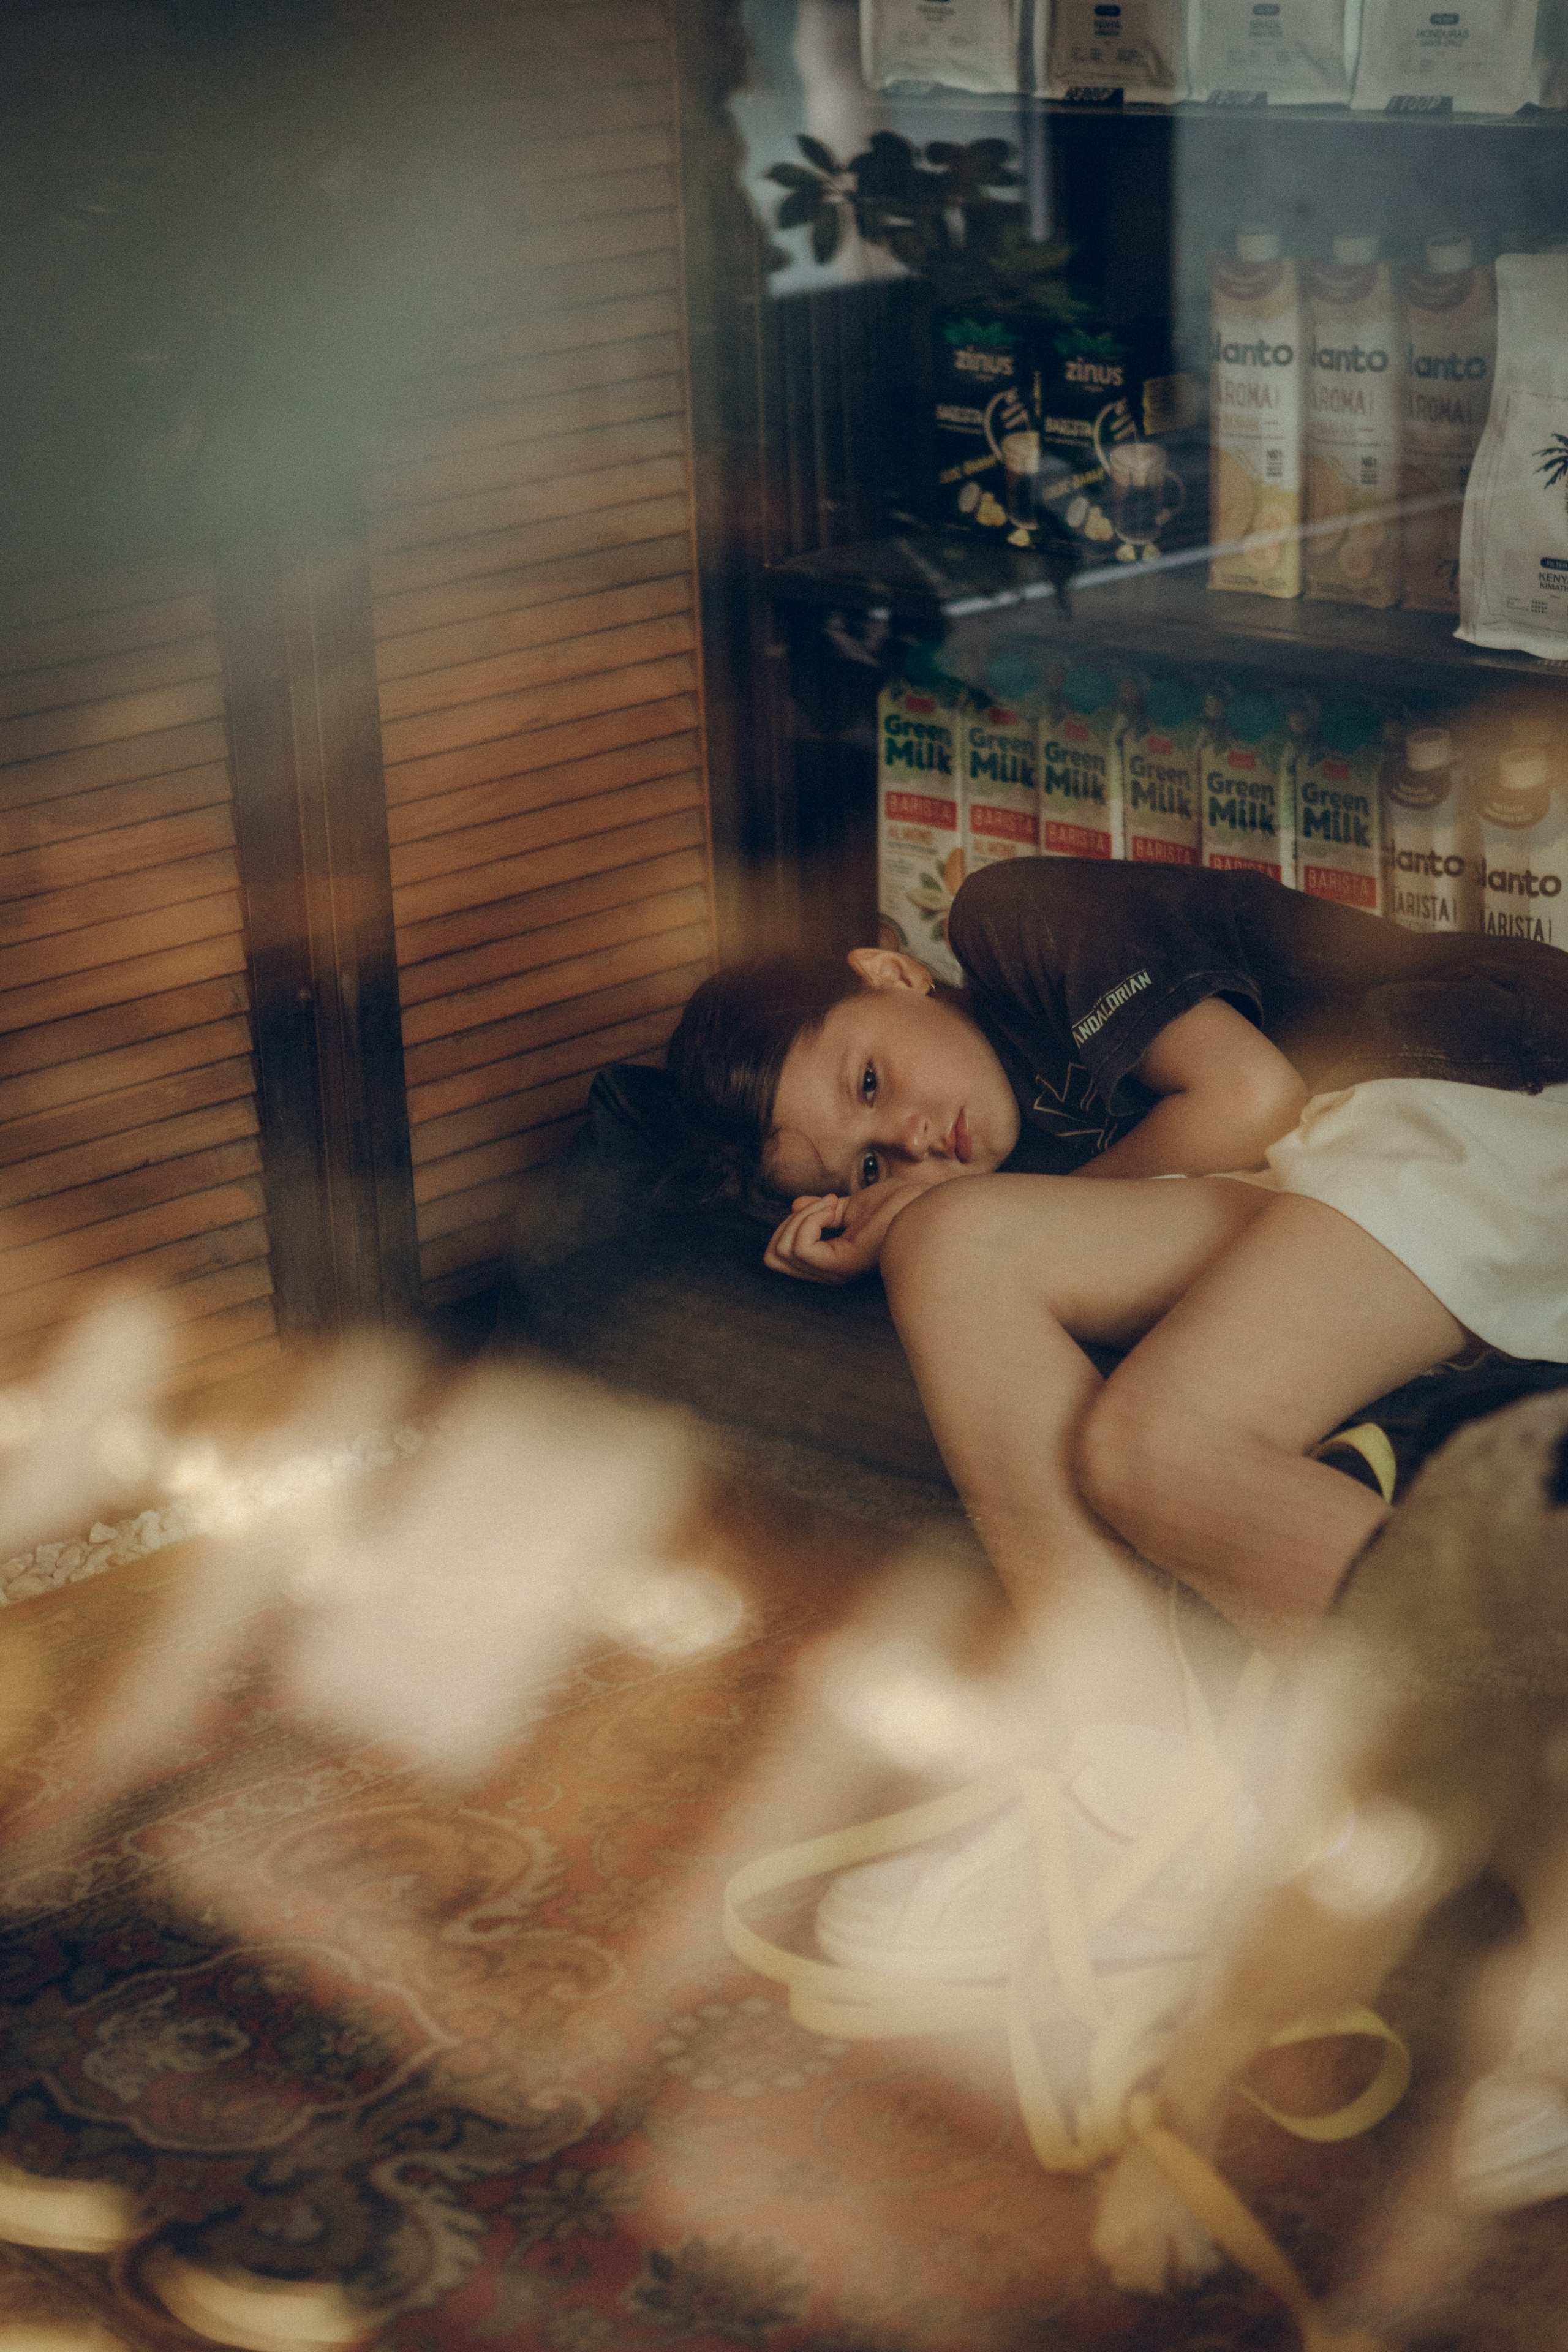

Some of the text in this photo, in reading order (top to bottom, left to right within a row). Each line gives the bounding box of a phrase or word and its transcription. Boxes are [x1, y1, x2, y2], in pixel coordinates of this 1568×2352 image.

[954, 345, 1013, 375] zinus
[1213, 331, 1294, 367] lanto
[1310, 336, 1389, 373] lanto
[1407, 343, 1487, 382] lanto
[1065, 356, 1123, 386] zinus
[1539, 571, 1568, 584] KENY
[884, 714, 952, 747] Green
[969, 727, 1034, 760] Green
[885, 737, 952, 775] Milk
[970, 750, 1034, 788] Milk
[1044, 741, 1106, 775] Green
[1129, 755, 1191, 790] Green
[1044, 764, 1106, 805] Milk
[1131, 779, 1191, 818] Milk
[1207, 771, 1275, 806] Green
[1302, 782, 1369, 817] Green
[1208, 796, 1276, 837] Milk
[1303, 807, 1371, 848] Milk
[1308, 870, 1369, 897] BARISTA
[1477, 858, 1562, 899] lanto
